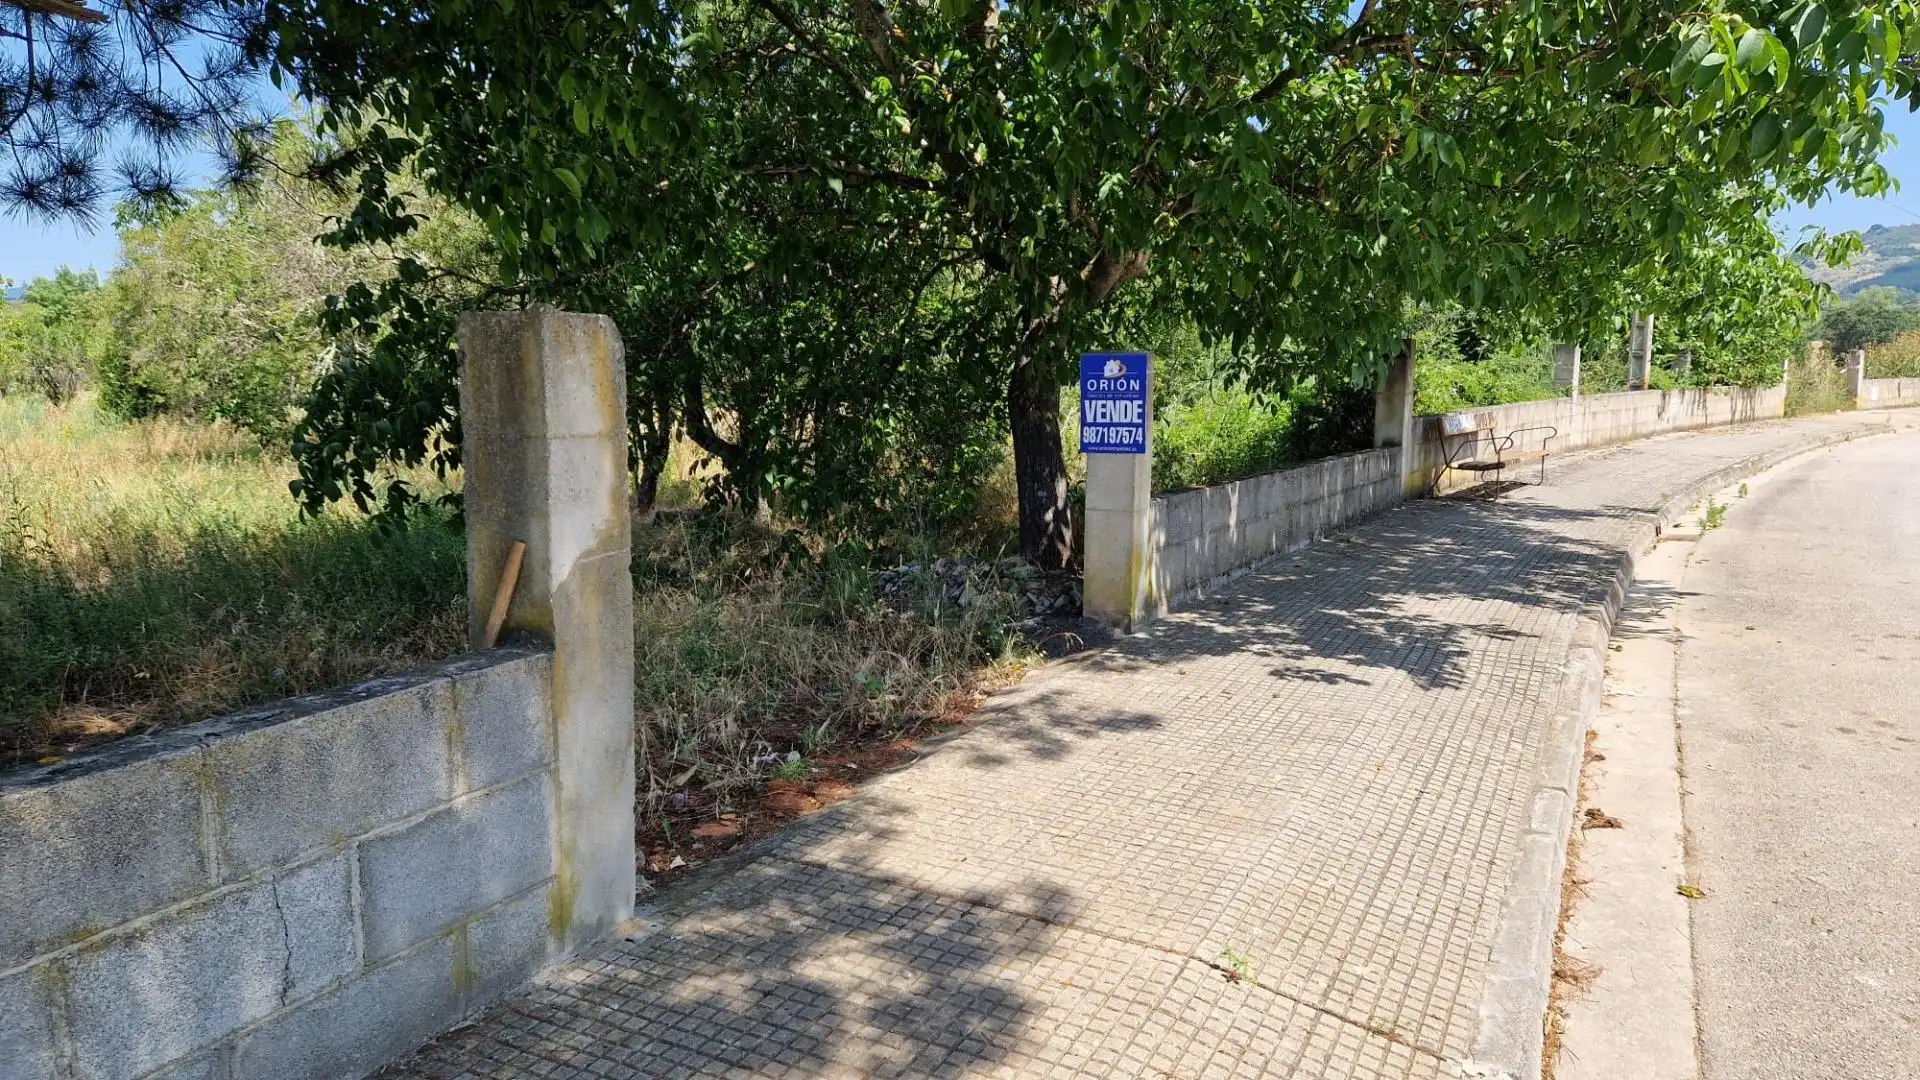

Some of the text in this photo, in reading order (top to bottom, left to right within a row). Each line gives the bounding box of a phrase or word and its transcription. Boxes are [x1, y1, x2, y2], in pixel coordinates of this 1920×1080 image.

[1087, 377, 1140, 391] ORIÓN
[1084, 400, 1143, 423] VENDE
[1083, 426, 1143, 444] 987197574
